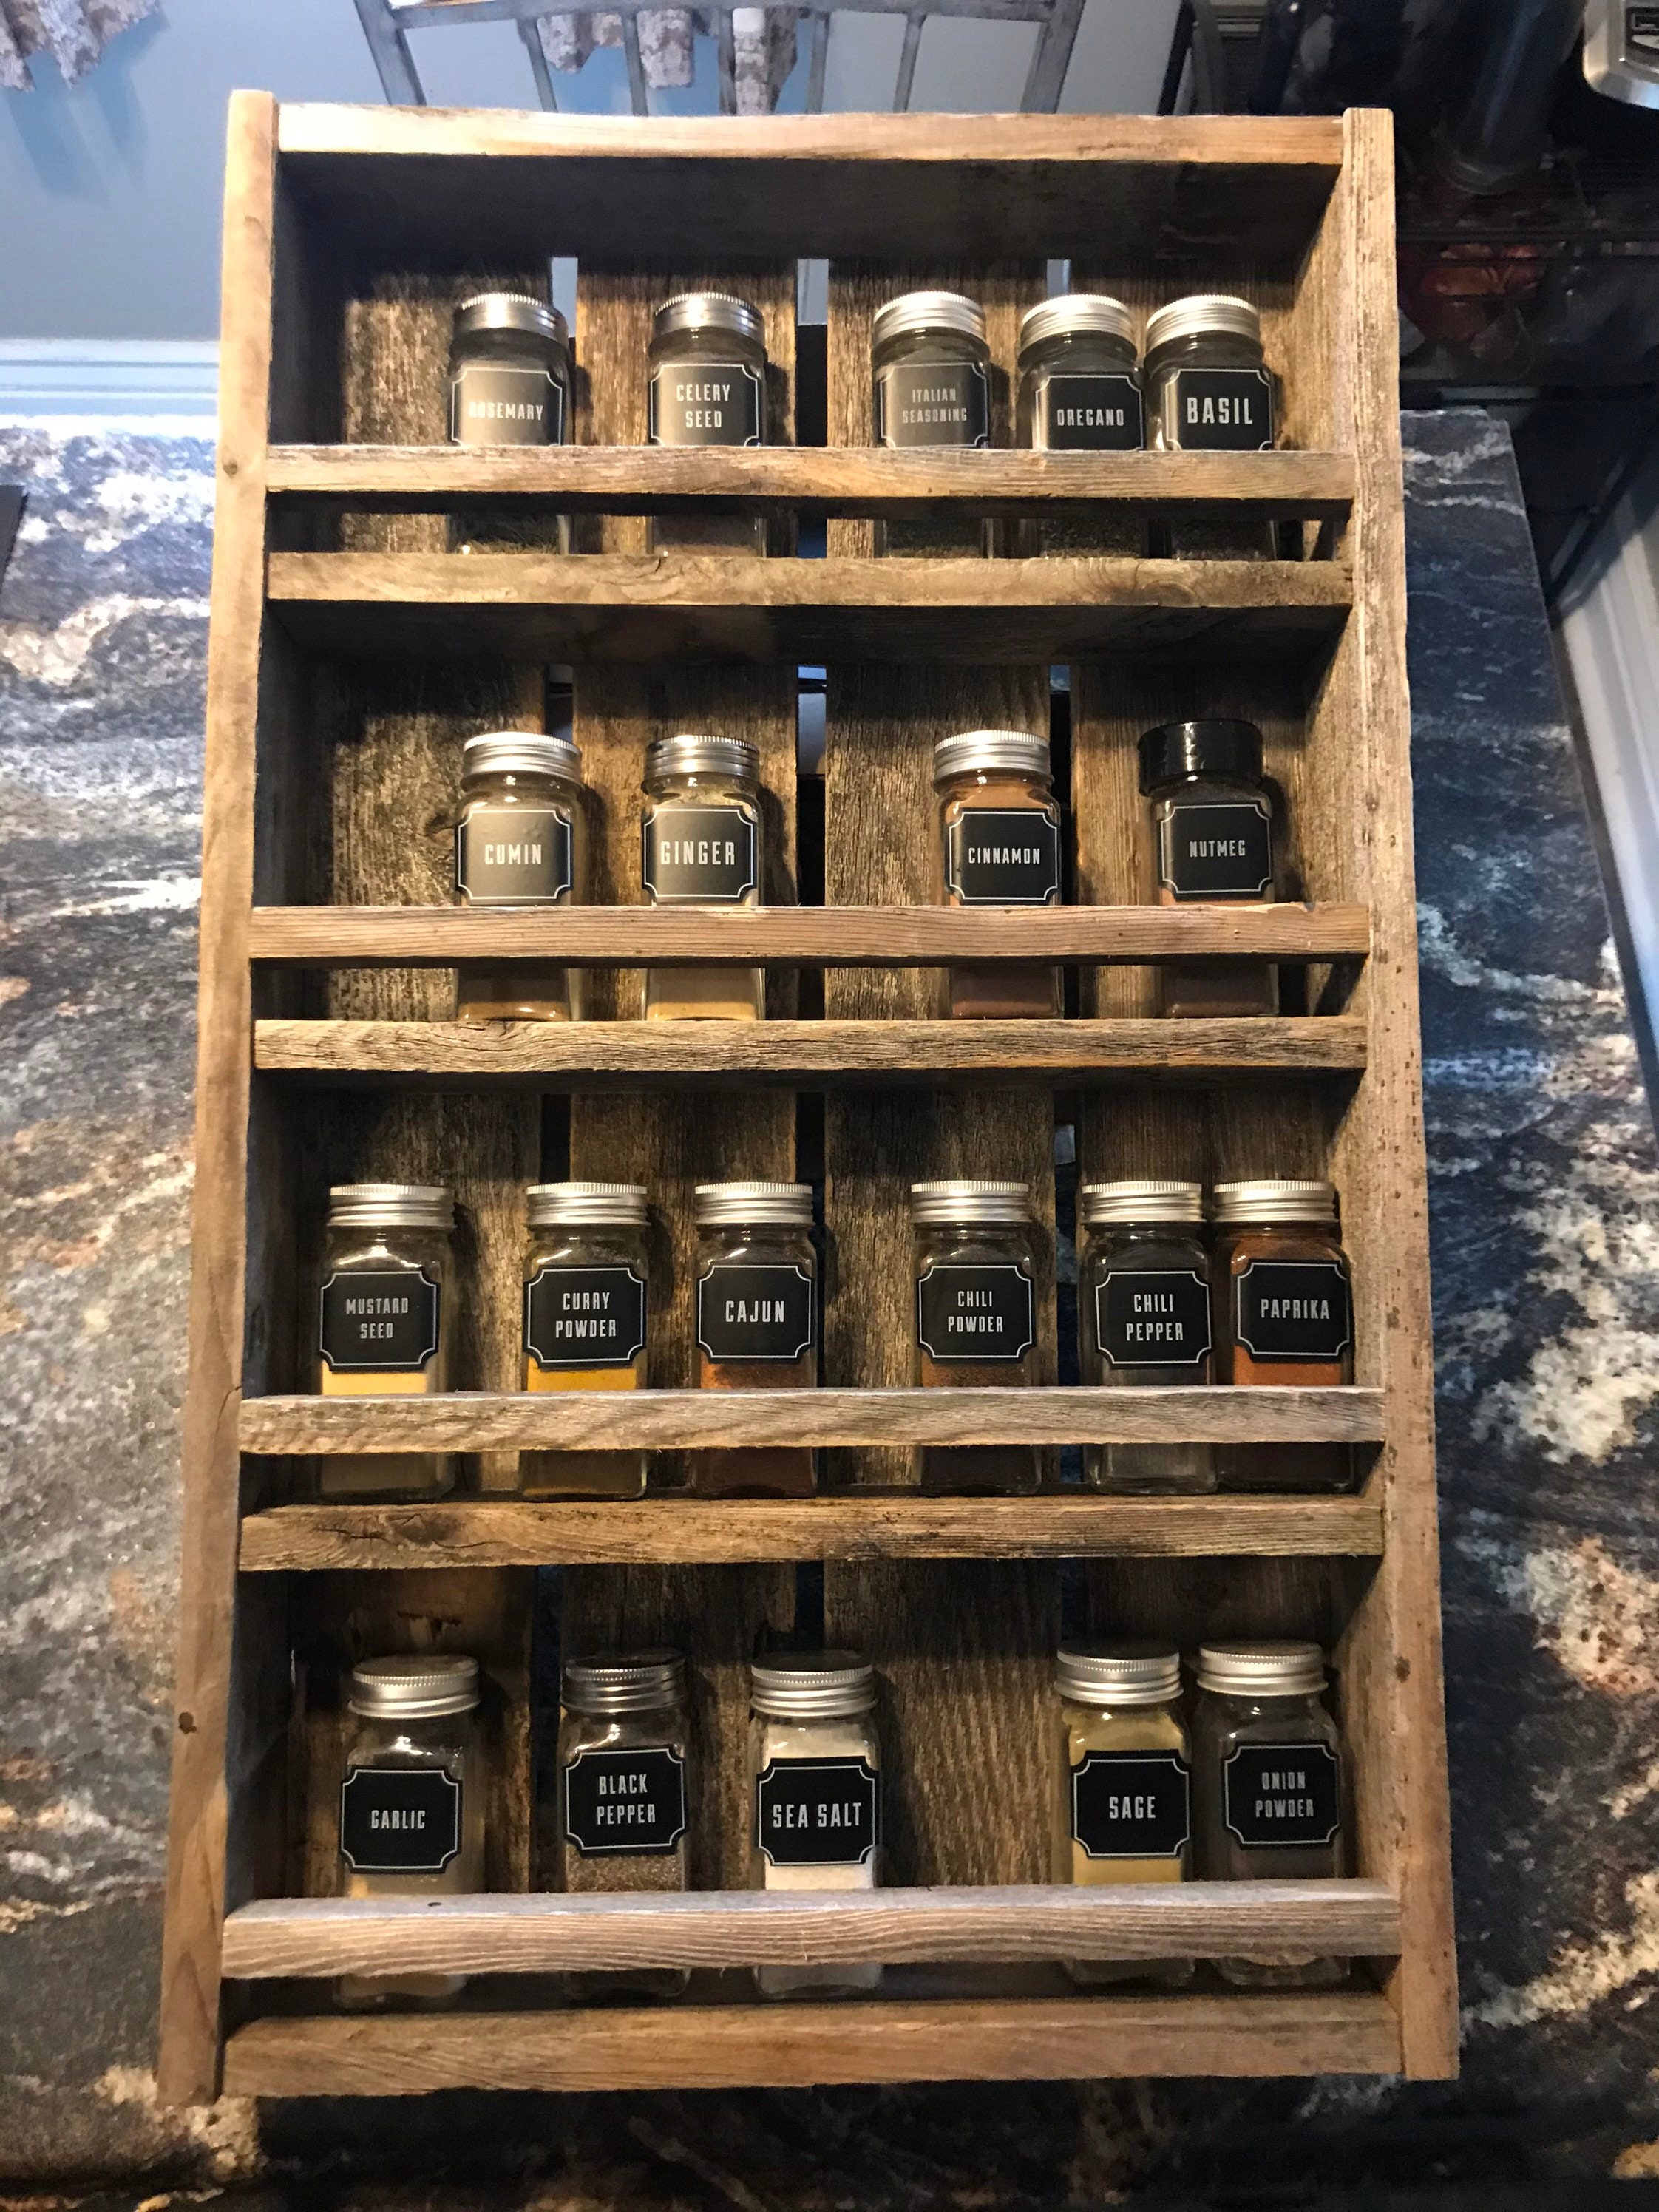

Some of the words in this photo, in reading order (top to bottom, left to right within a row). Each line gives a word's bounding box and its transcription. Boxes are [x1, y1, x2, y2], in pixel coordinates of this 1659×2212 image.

[676, 384, 730, 403] CELERY
[912, 388, 957, 403] ITALIAN
[685, 410, 722, 428] SEED
[903, 408, 967, 424] SEASONING
[1056, 409, 1124, 427] OREGANO
[1187, 397, 1253, 425] BASIL
[484, 844, 542, 865] CUMIN
[660, 841, 735, 865] GINGER
[968, 847, 1041, 865] CINNAMON
[1189, 839, 1246, 858] NUTMEG
[346, 1297, 409, 1314] MUSTARD
[563, 1292, 612, 1311] CURRY
[957, 1291, 993, 1307] CHILI
[1133, 1294, 1174, 1312] CHILI
[725, 1300, 785, 1323] CAJUN
[1261, 1298, 1330, 1320] PAPRIKA
[359, 1323, 394, 1339] SEED
[555, 1319, 617, 1338] POWDER
[948, 1316, 1004, 1332] POWDER
[1126, 1323, 1184, 1341] PEPPER
[598, 1774, 648, 1795] BLACK
[1261, 1771, 1306, 1791] ONION
[596, 1804, 657, 1825] PEPPER
[773, 1804, 809, 1828] SEA
[818, 1802, 862, 1828] SALT
[1109, 1796, 1156, 1819] SAGE
[1255, 1799, 1314, 1818] POWDER
[370, 1809, 427, 1830] GARLIC
